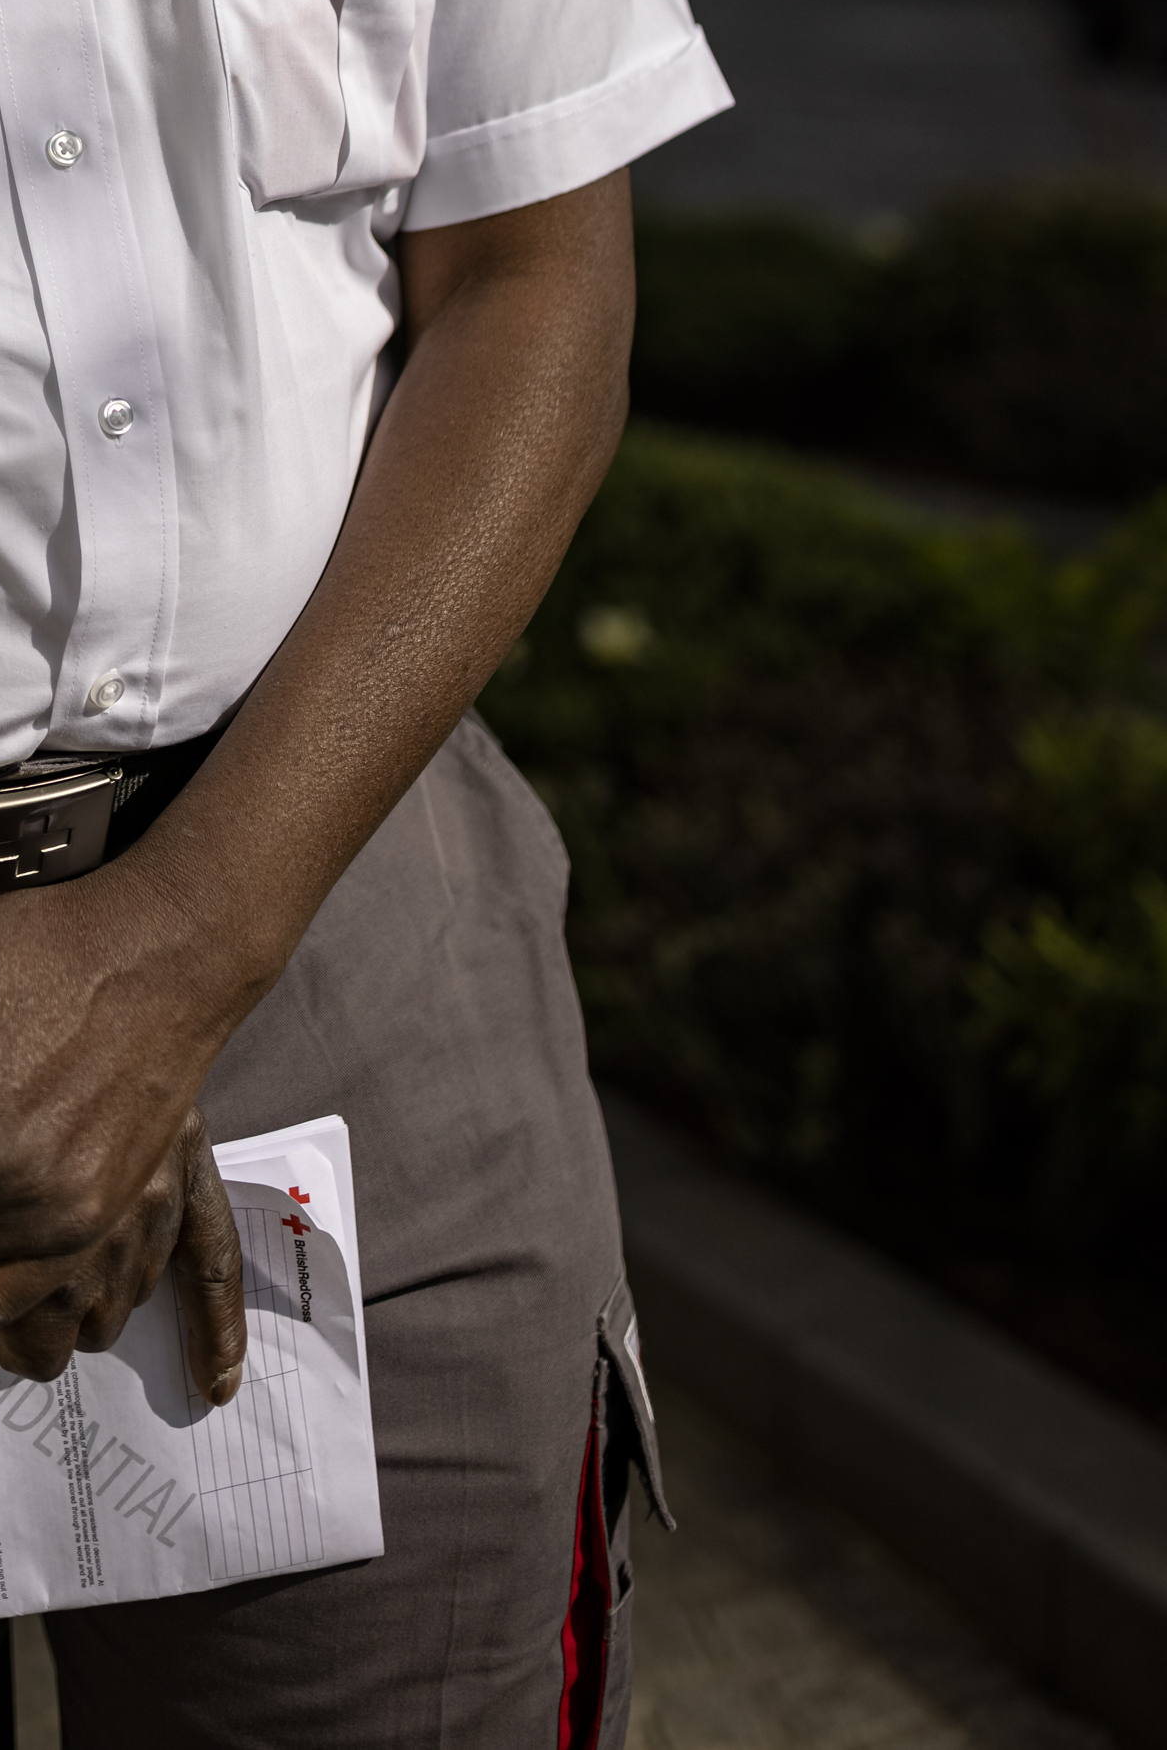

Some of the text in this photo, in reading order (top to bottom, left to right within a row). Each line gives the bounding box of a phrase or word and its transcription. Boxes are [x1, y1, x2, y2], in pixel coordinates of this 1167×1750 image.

[294, 1239, 312, 1323] BritishRedCross
[62, 1371, 70, 1387] must
[58, 1398, 64, 1406] be
[63, 1389, 72, 1402] sign
[70, 1371, 83, 1418] (chronological)
[59, 1409, 67, 1427] made
[60, 1429, 68, 1437] by
[70, 1432, 78, 1444] last
[77, 1419, 85, 1440] record
[63, 1447, 72, 1466] single
[71, 1446, 80, 1462] entry
[66, 1468, 74, 1479] line
[68, 1482, 76, 1504] scored
[84, 1482, 93, 1505] options
[70, 1506, 80, 1530] through
[88, 1507, 98, 1541] considered
[74, 1533, 82, 1543] the
[80, 1518, 89, 1542] unused
[76, 1545, 84, 1561] word
[78, 1563, 86, 1575] and
[93, 1547, 103, 1578] decisions.
[0, 1580, 7, 1591] out
